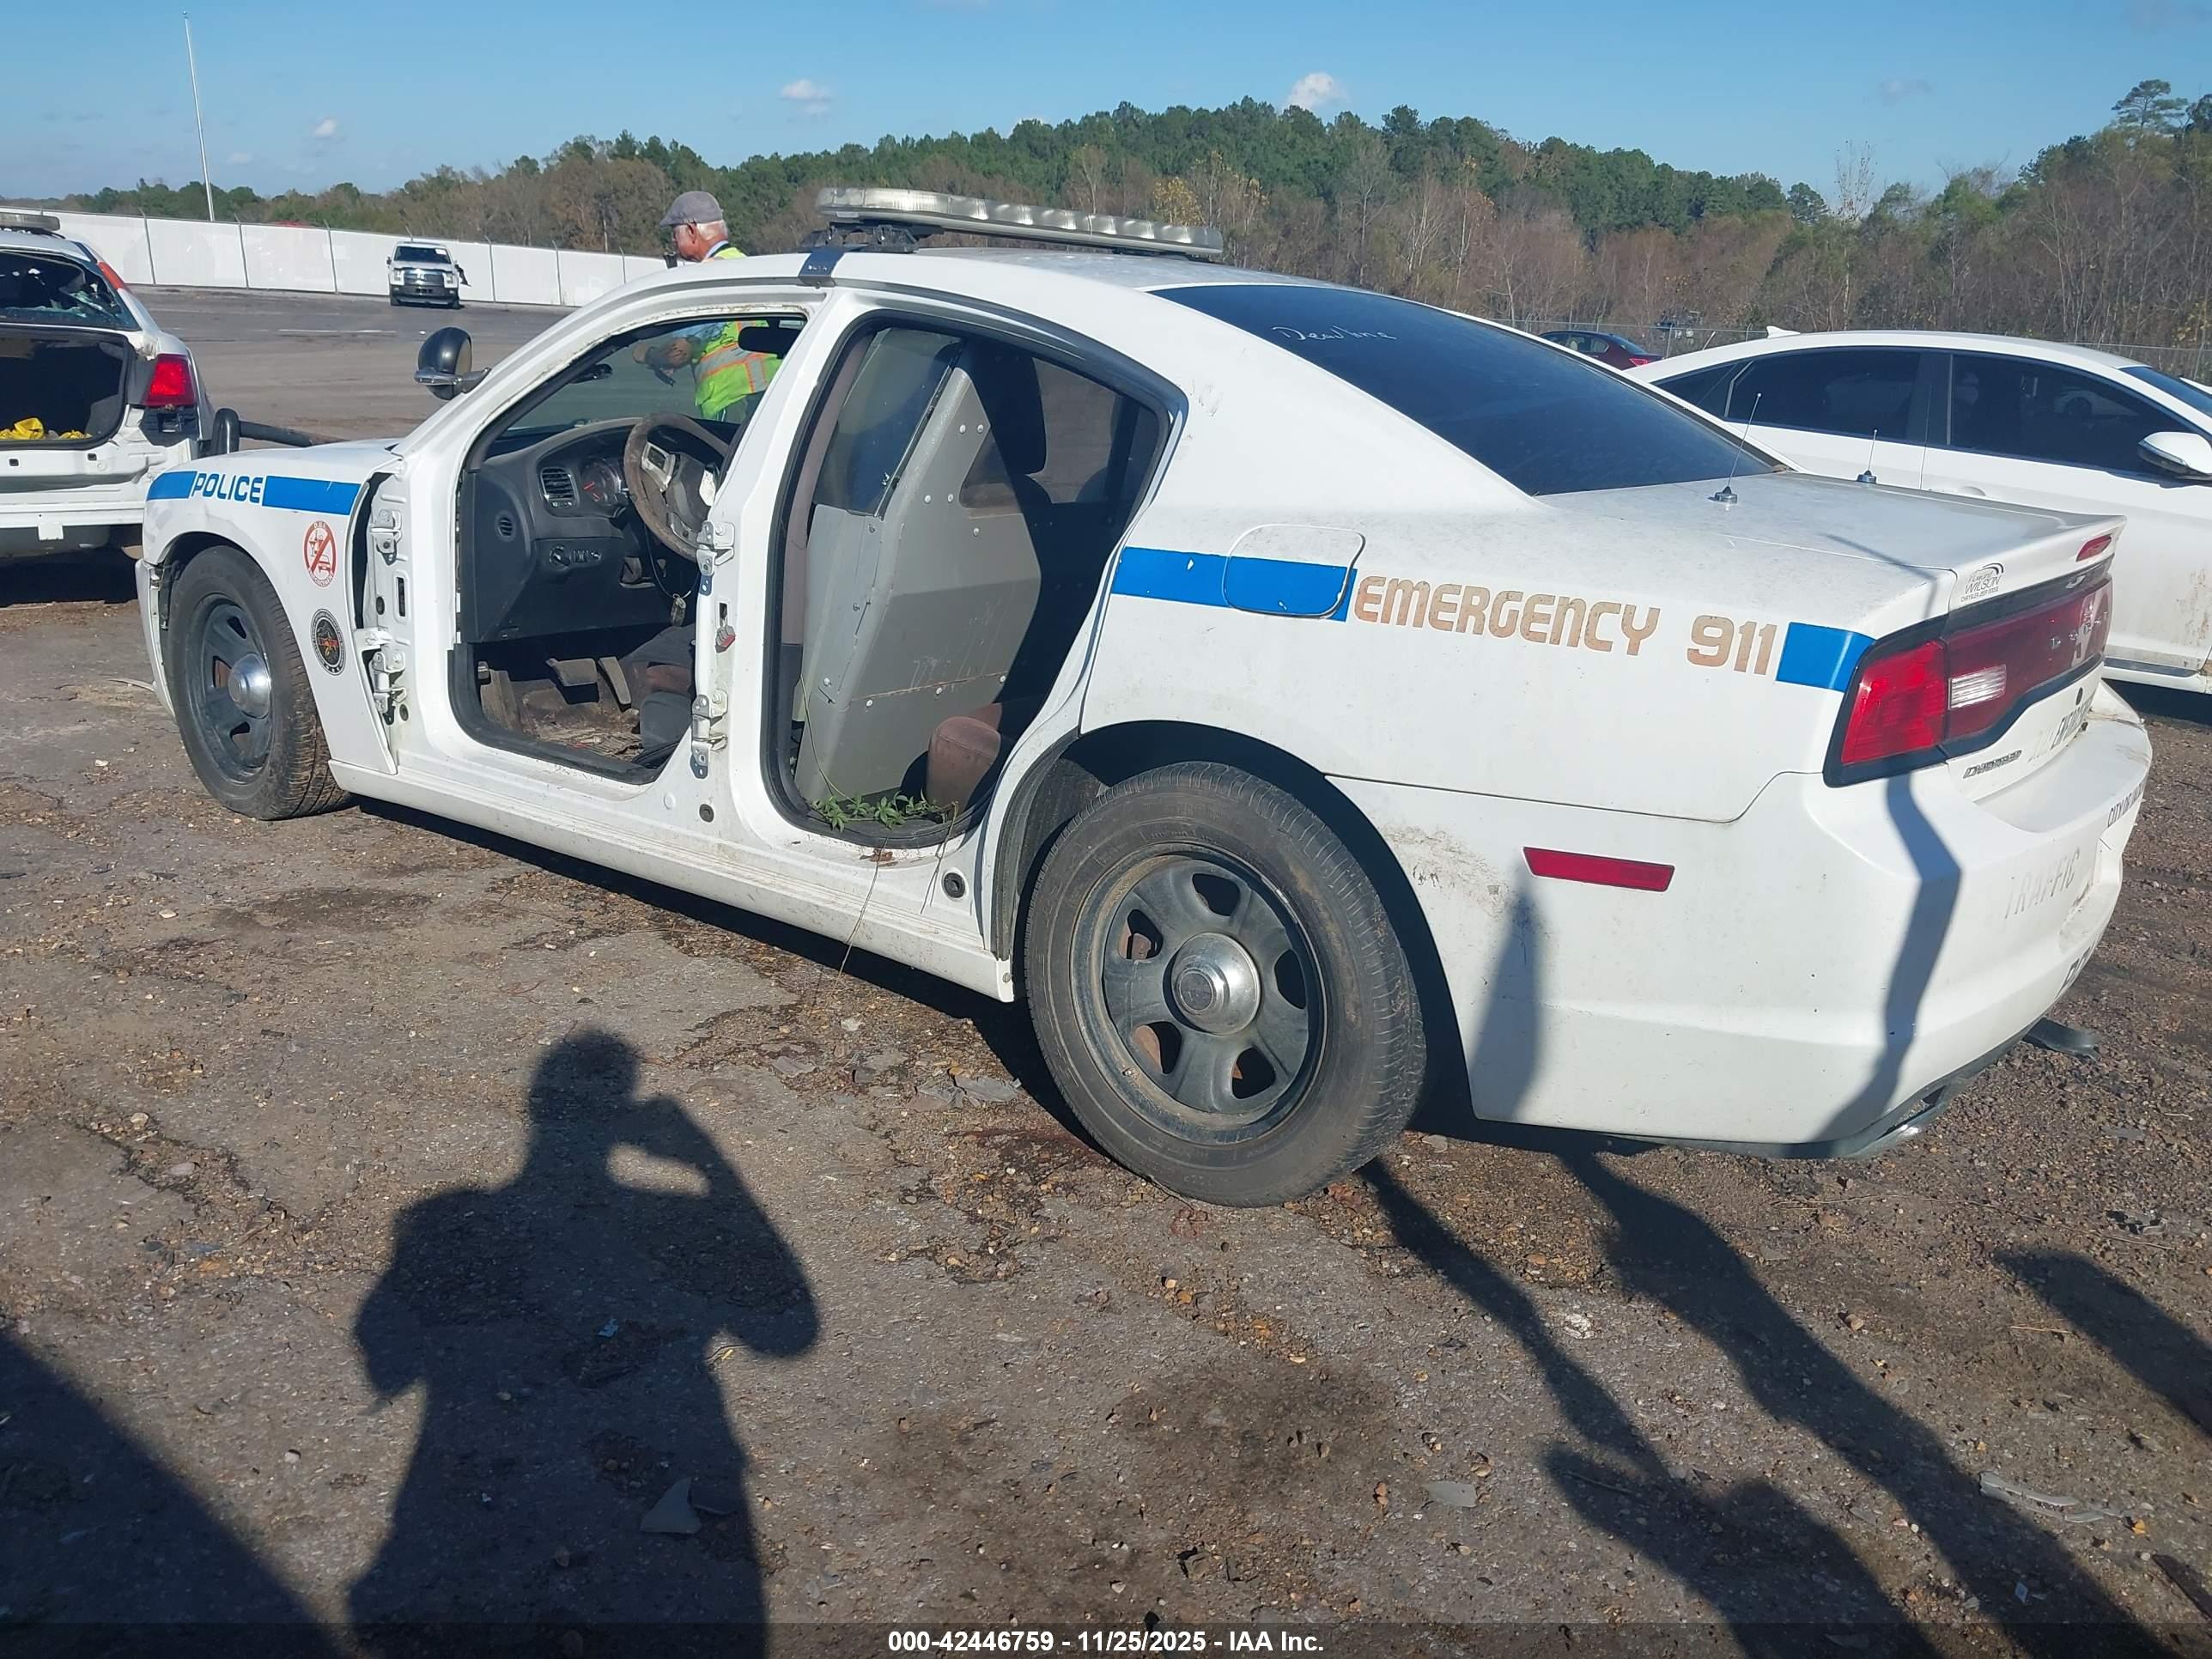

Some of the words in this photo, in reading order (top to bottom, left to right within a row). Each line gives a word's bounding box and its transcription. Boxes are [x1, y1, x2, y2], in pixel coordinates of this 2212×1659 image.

[191, 472, 264, 503] POLICE
[1965, 574, 2002, 594] WILSON
[1354, 575, 1661, 656] EMERGENCY
[1686, 614, 1778, 676] 911
[2107, 799, 2124, 827] CITY
